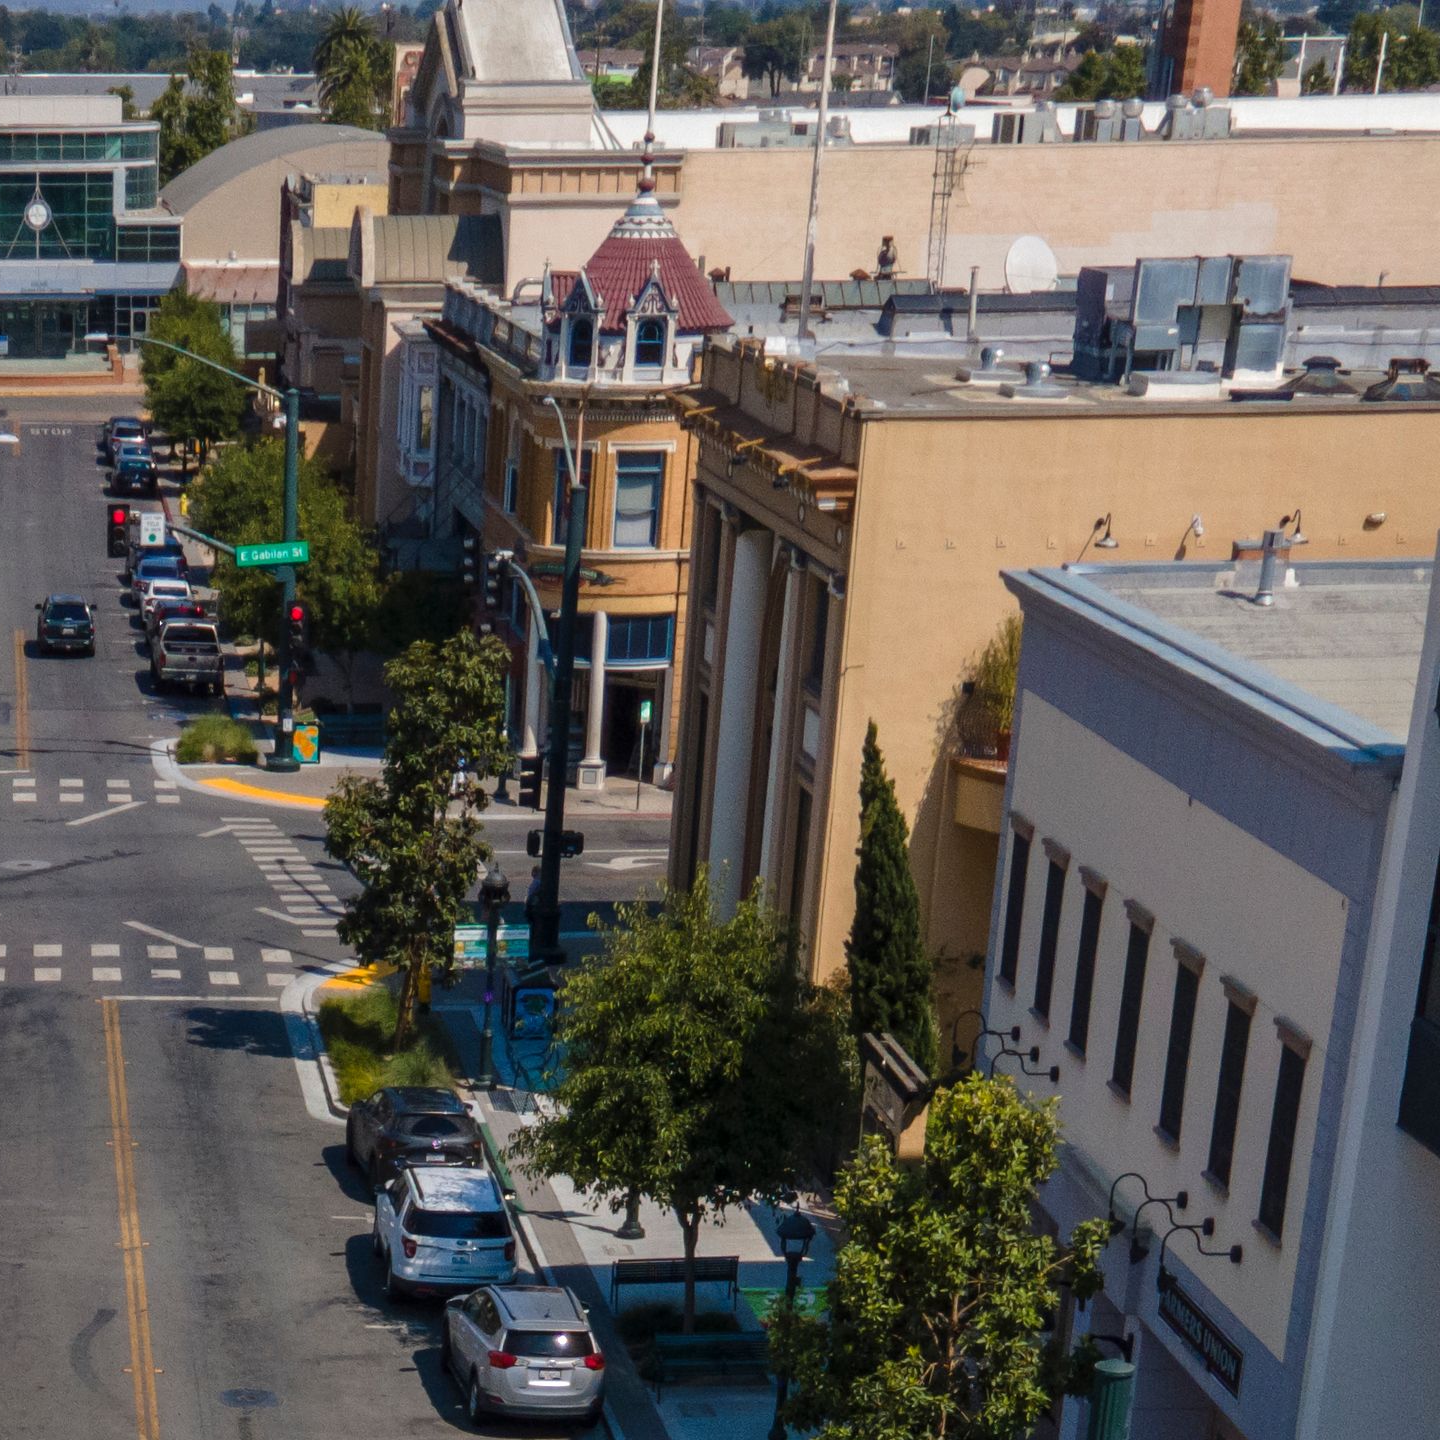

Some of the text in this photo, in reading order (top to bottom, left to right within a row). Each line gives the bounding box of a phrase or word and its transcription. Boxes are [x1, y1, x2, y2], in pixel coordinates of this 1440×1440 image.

[240, 547, 304, 561] E Gabilan St
